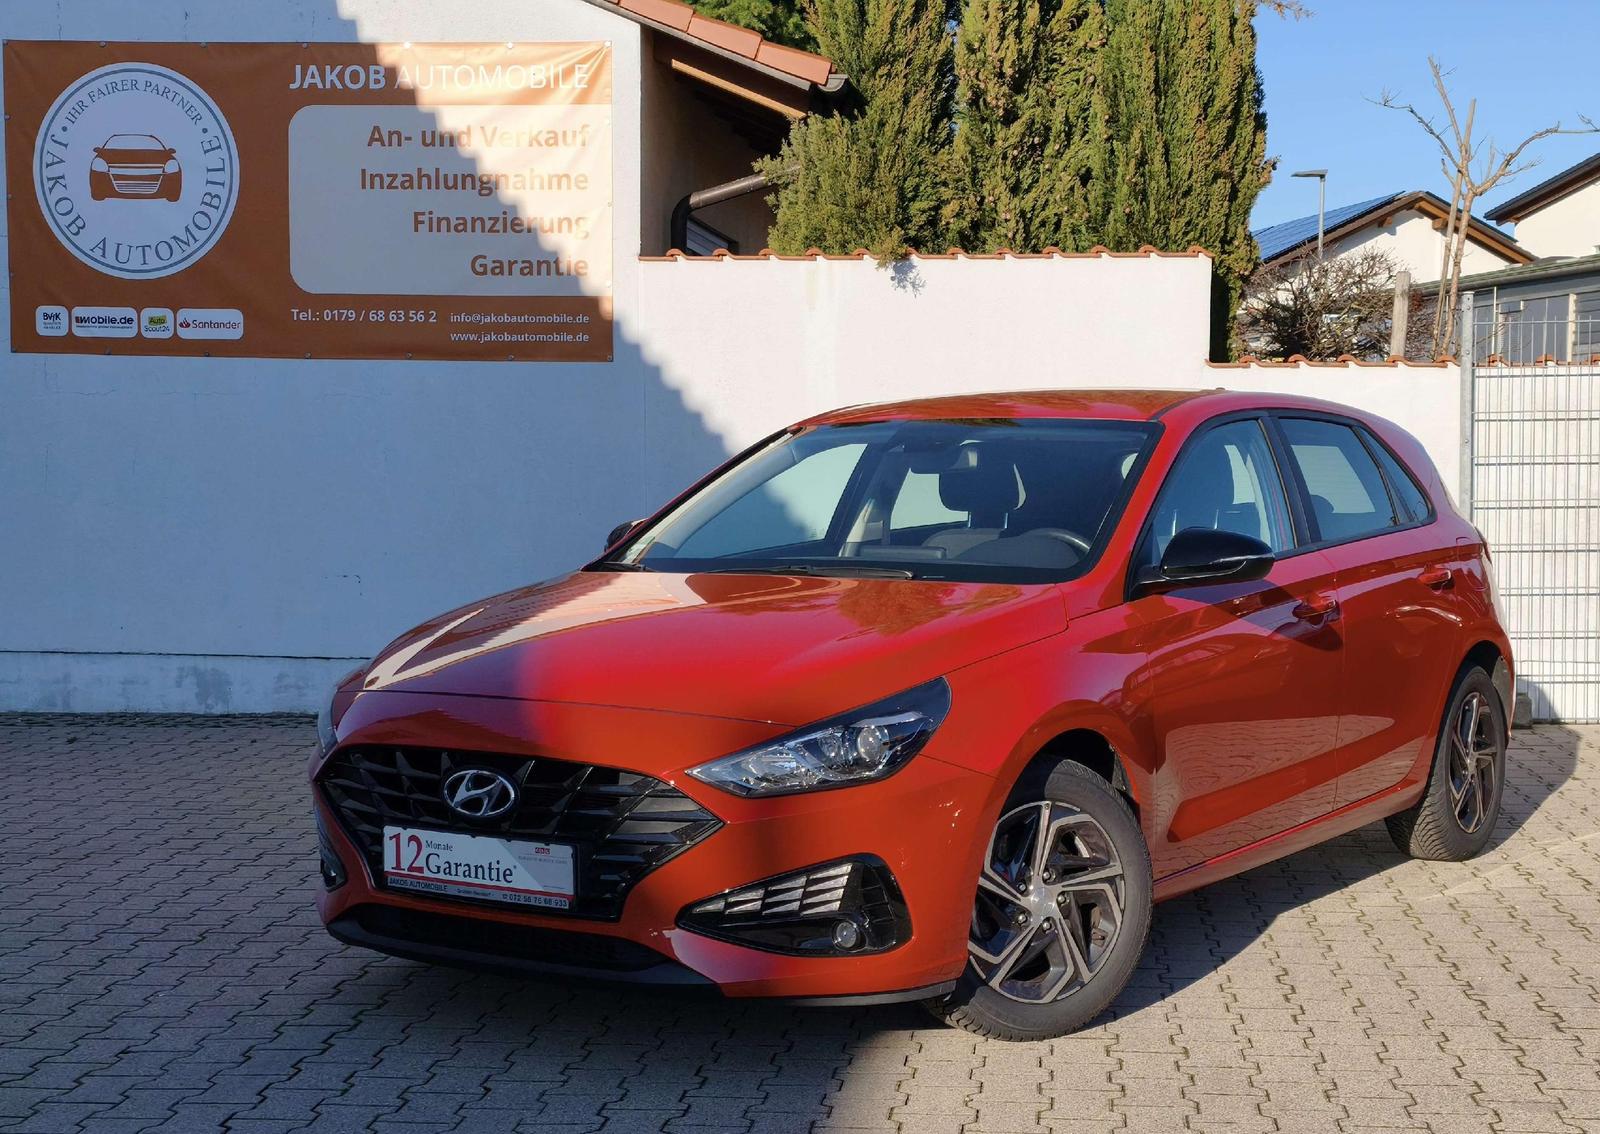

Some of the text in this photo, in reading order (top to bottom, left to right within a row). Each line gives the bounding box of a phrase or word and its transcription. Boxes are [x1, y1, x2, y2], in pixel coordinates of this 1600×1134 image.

[289, 64, 588, 90] JAKOB AUTOMOBILE
[65, 79, 204, 125] IHR FAIRER PARTNER
[367, 124, 591, 148] An- und Verkauf
[360, 168, 588, 197] Inzahlungnahme
[45, 133, 226, 267] JAKOB AUTOMOBILE
[413, 211, 590, 240] Finanzierung
[470, 254, 589, 277] Garantie
[79, 315, 135, 325] mobile.de
[149, 317, 166, 325] Auto
[191, 319, 241, 330] Santander
[291, 309, 320, 321] Tel.:
[323, 310, 356, 322] 0179
[368, 310, 386, 322] 68
[388, 310, 405, 322] 63
[408, 311, 426, 323] 56
[428, 311, 437, 323] 2
[450, 312, 590, 325] info@jakobautomobile.de
[144, 325, 171, 333] Scout24
[450, 330, 590, 343] www.jakobautomobile.de
[388, 832, 425, 875] 12
[424, 839, 454, 852] Monate
[425, 852, 514, 883] Garantie
